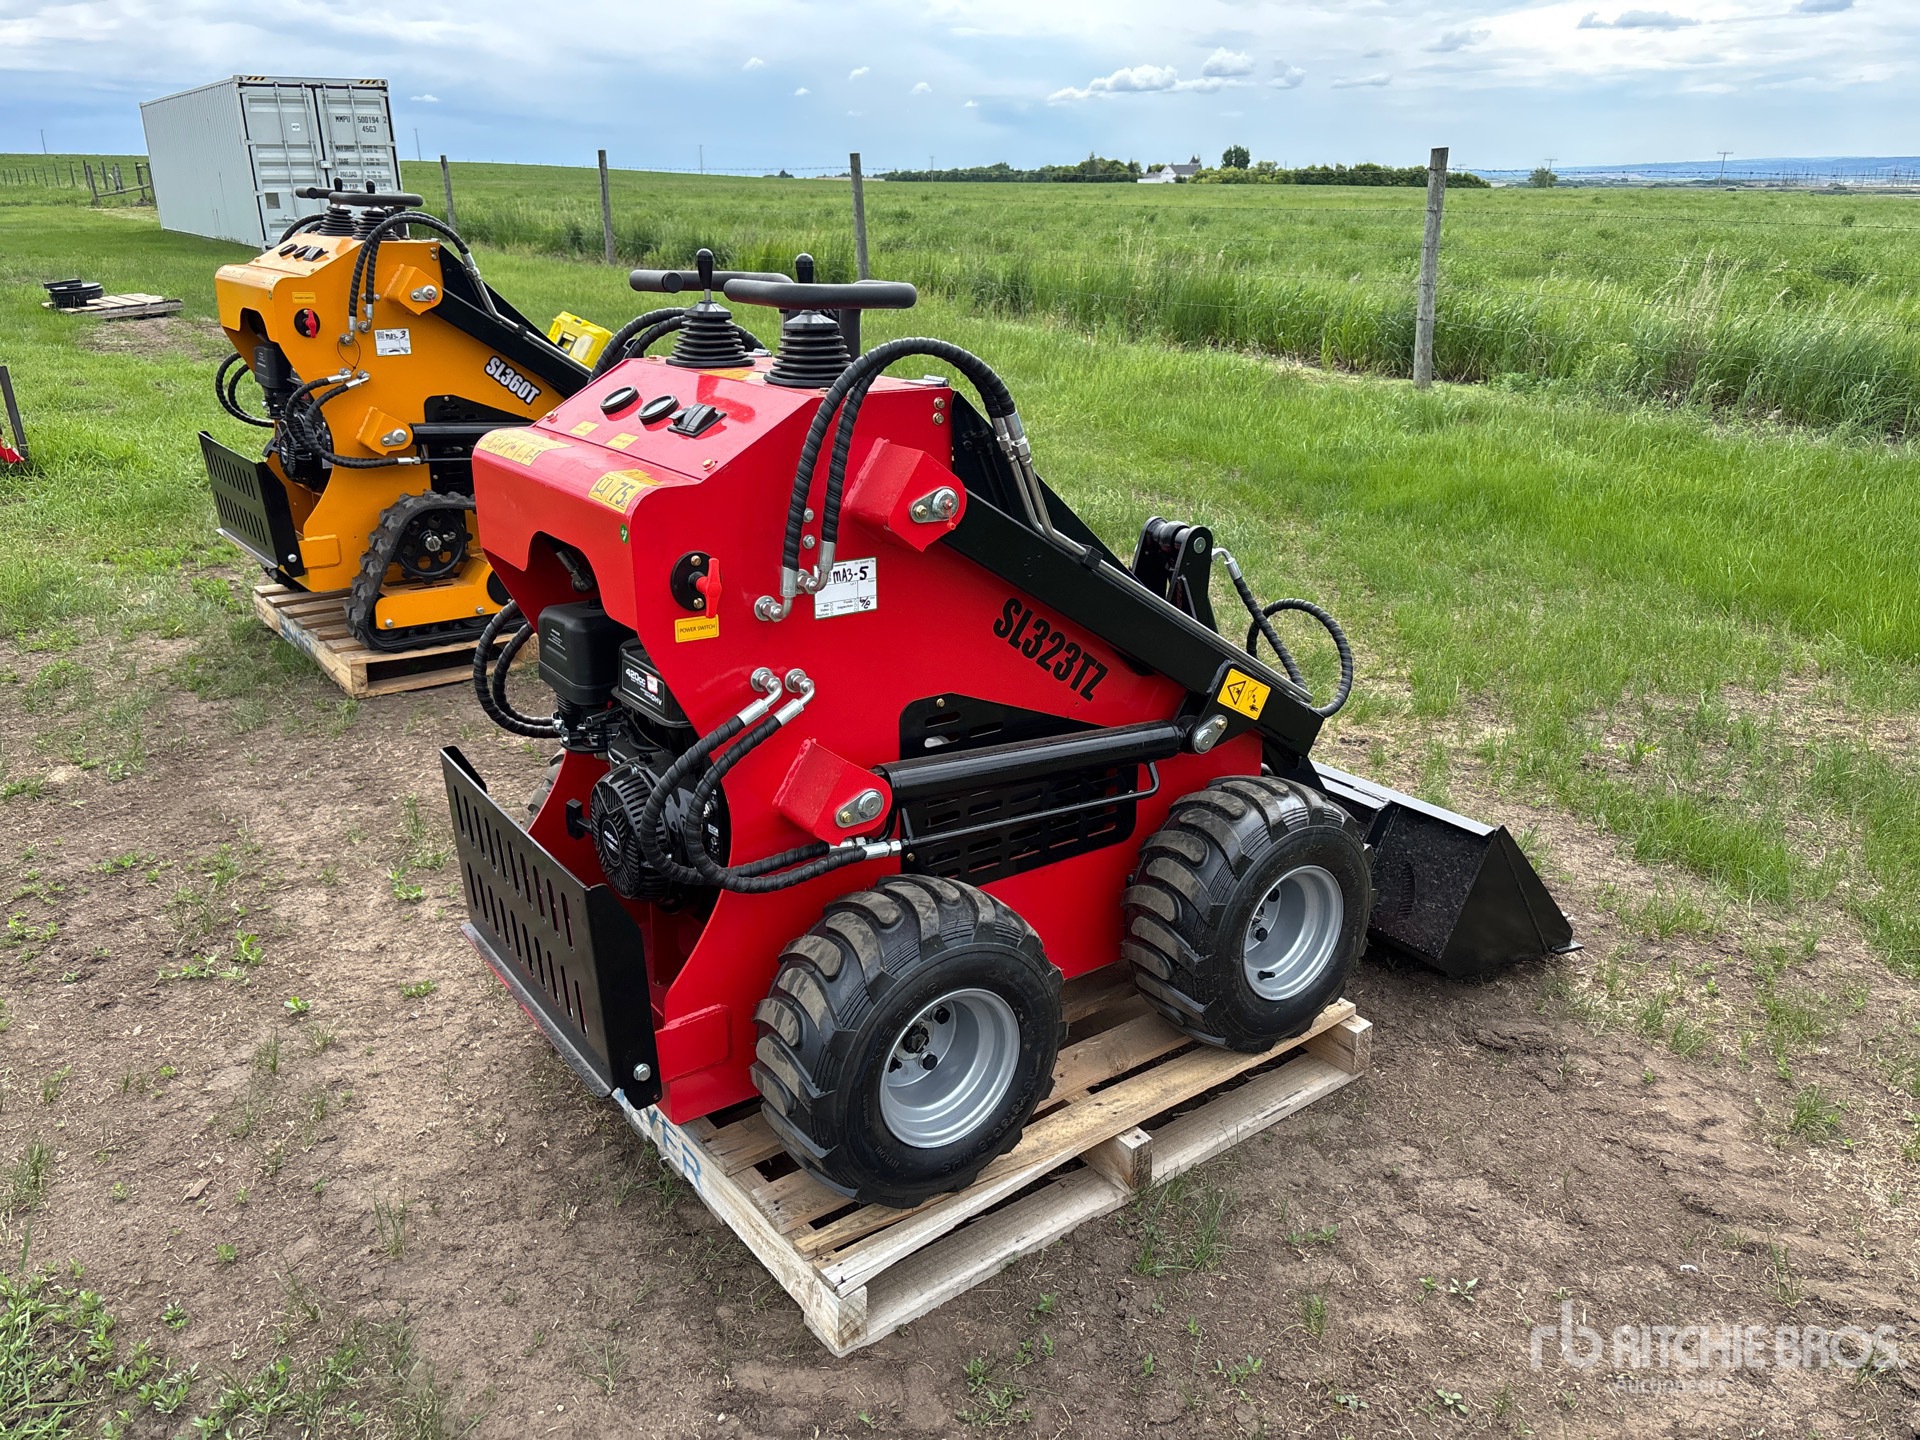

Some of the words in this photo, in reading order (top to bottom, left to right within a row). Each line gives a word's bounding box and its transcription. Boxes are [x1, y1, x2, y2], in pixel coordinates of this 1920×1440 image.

[357, 116, 379, 124] 500194
[382, 116, 388, 124] 2
[485, 356, 541, 404] SL360T
[993, 598, 1109, 702] SL323TZ
